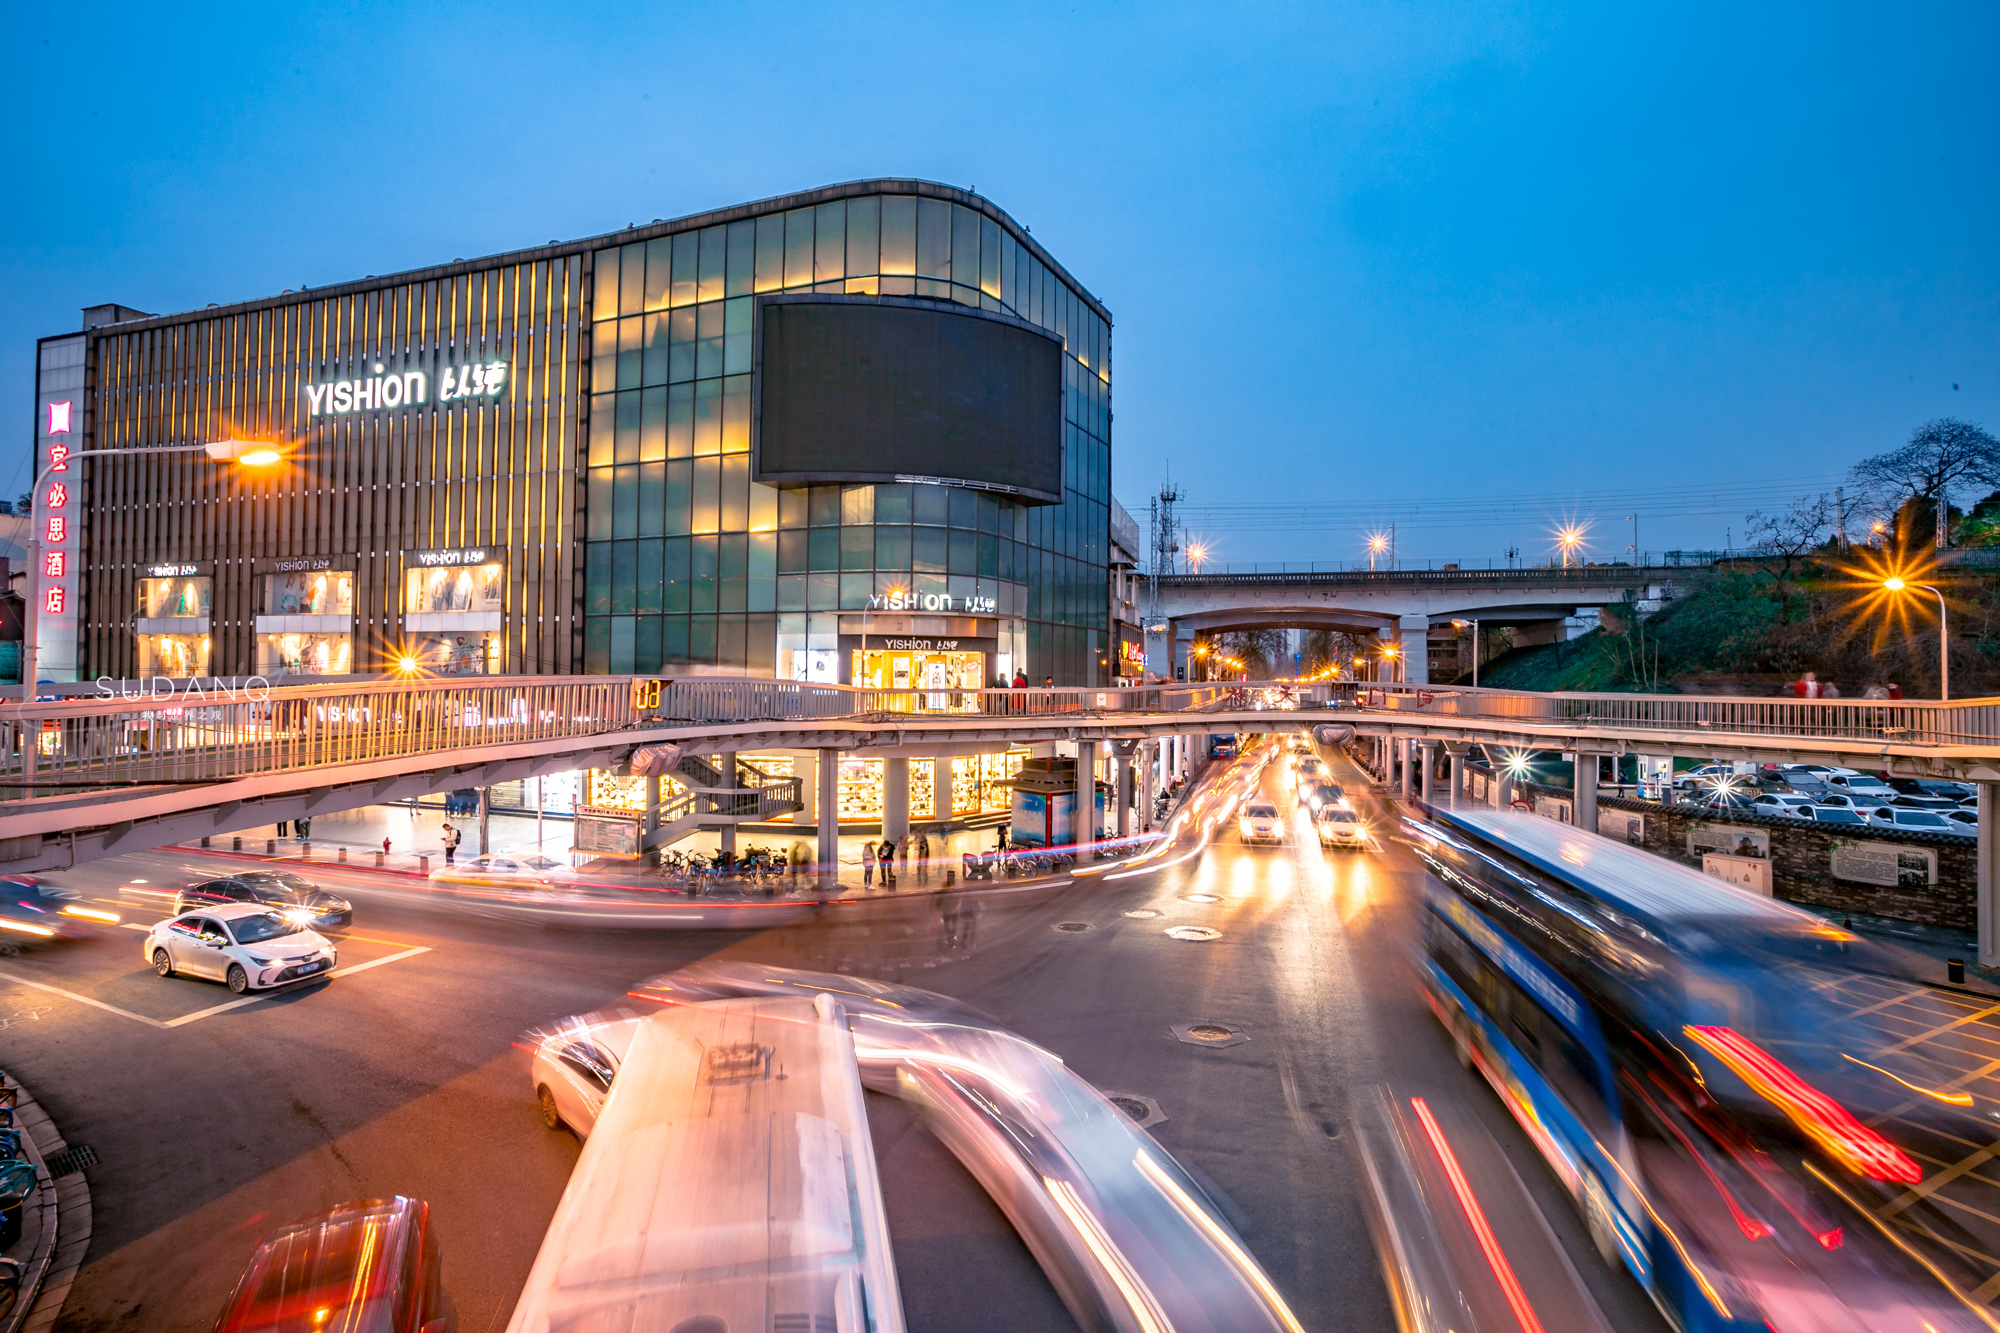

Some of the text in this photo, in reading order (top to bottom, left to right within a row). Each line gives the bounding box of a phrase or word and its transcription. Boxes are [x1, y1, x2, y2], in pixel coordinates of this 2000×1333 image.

[46, 445, 68, 614] 宜必思酒店
